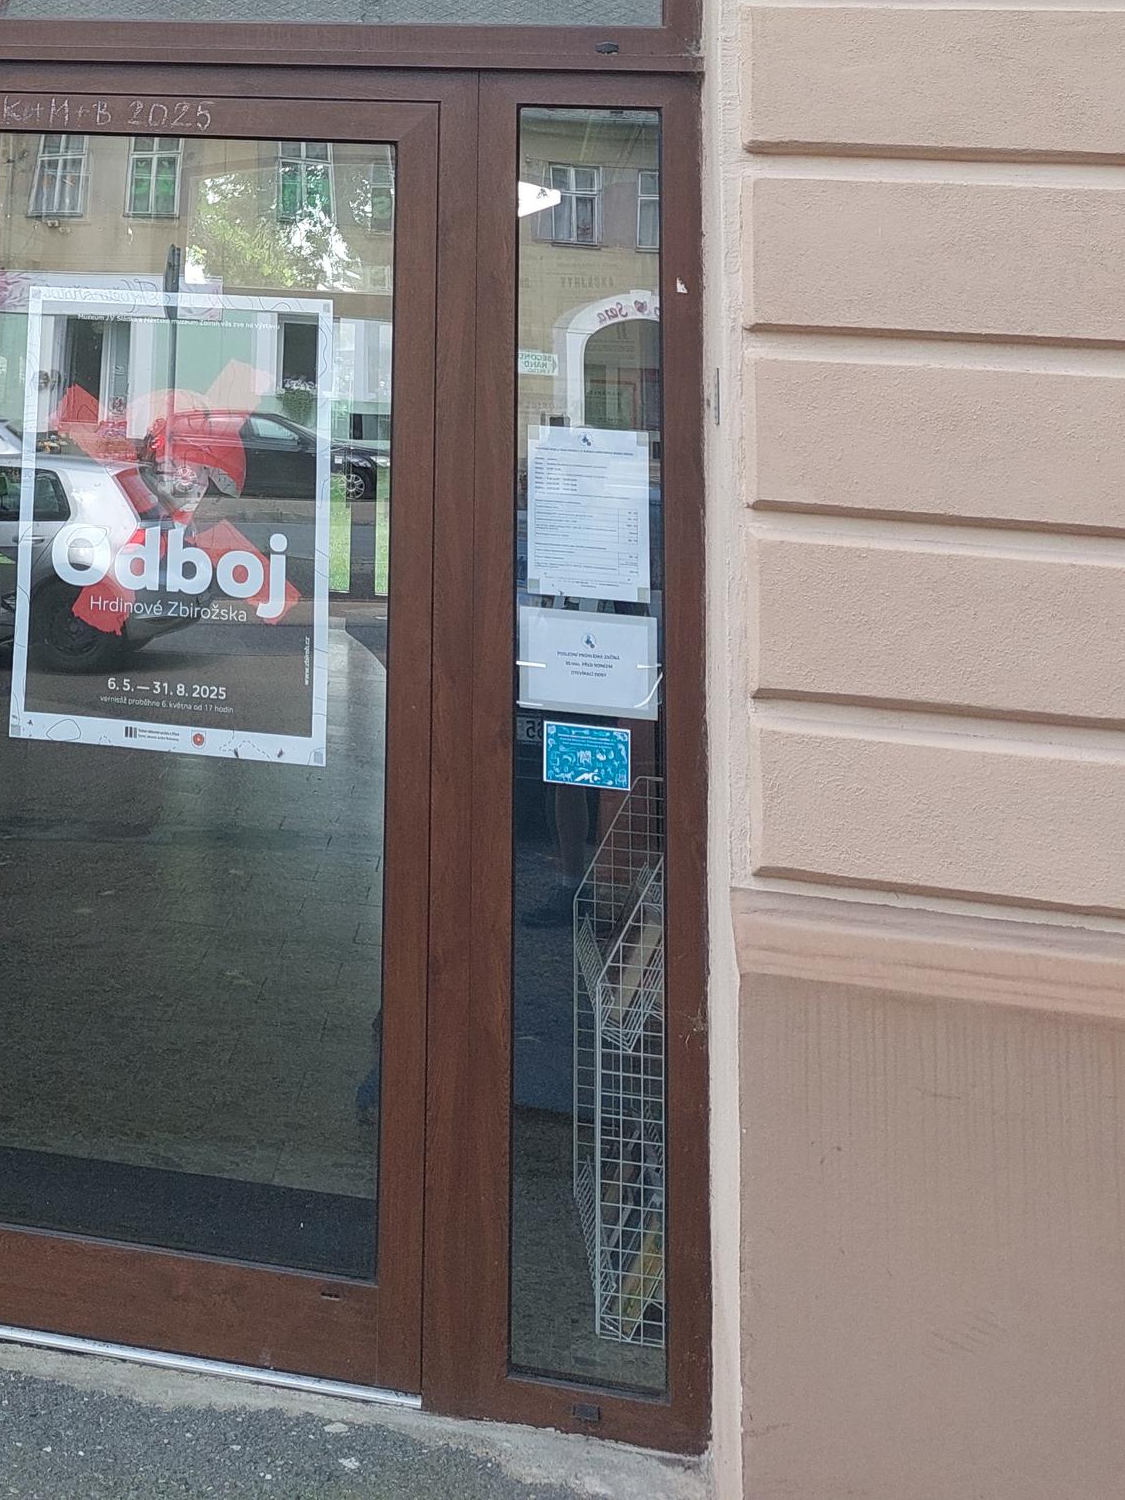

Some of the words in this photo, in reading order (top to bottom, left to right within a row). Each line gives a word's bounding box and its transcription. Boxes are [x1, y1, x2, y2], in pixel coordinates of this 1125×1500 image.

[127, 99, 216, 132] 2025
[52, 523, 288, 619] Odboj
[90, 595, 163, 616] Hrdinové
[167, 601, 248, 622] Zbirožska
[107, 677, 119, 691] 6.
[122, 678, 135, 692] 5.
[153, 681, 173, 696] 31.
[176, 683, 189, 697] 8.
[192, 684, 227, 700] 2025
[193, 703, 203, 711] od
[204, 704, 213, 712] 17
[214, 705, 234, 714] hodin
